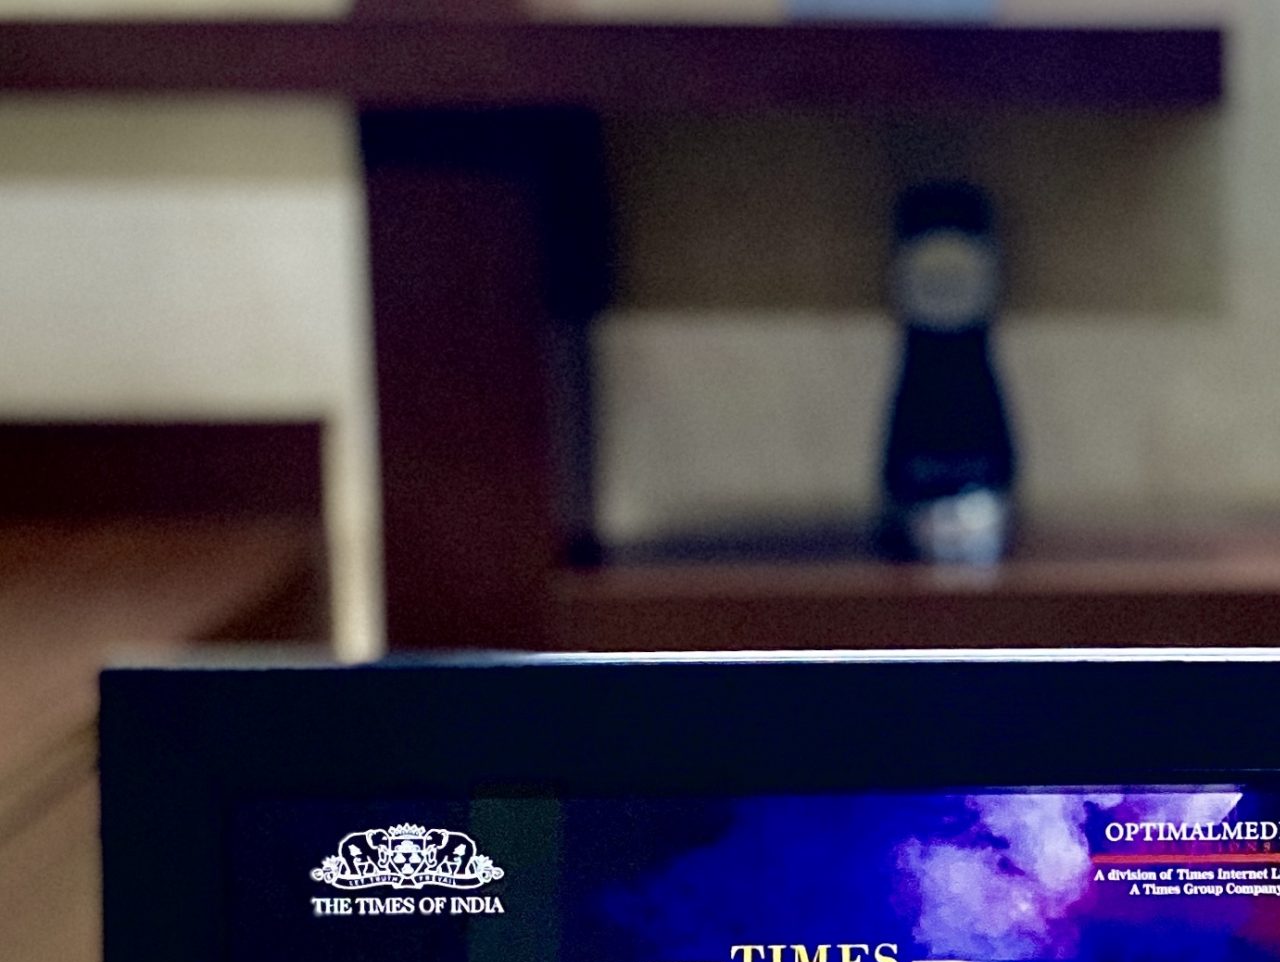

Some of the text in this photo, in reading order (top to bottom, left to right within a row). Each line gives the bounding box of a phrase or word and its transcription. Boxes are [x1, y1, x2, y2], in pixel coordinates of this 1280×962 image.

[1094, 869, 1105, 881] A
[1107, 869, 1156, 881] division
[1159, 868, 1174, 880] of
[1176, 868, 1215, 880] Times
[1217, 868, 1268, 880] Internet
[1129, 883, 1140, 895] A
[1142, 883, 1180, 895] Times
[1183, 883, 1223, 896] Group
[311, 897, 504, 915] THE TIMES OF INDIA
